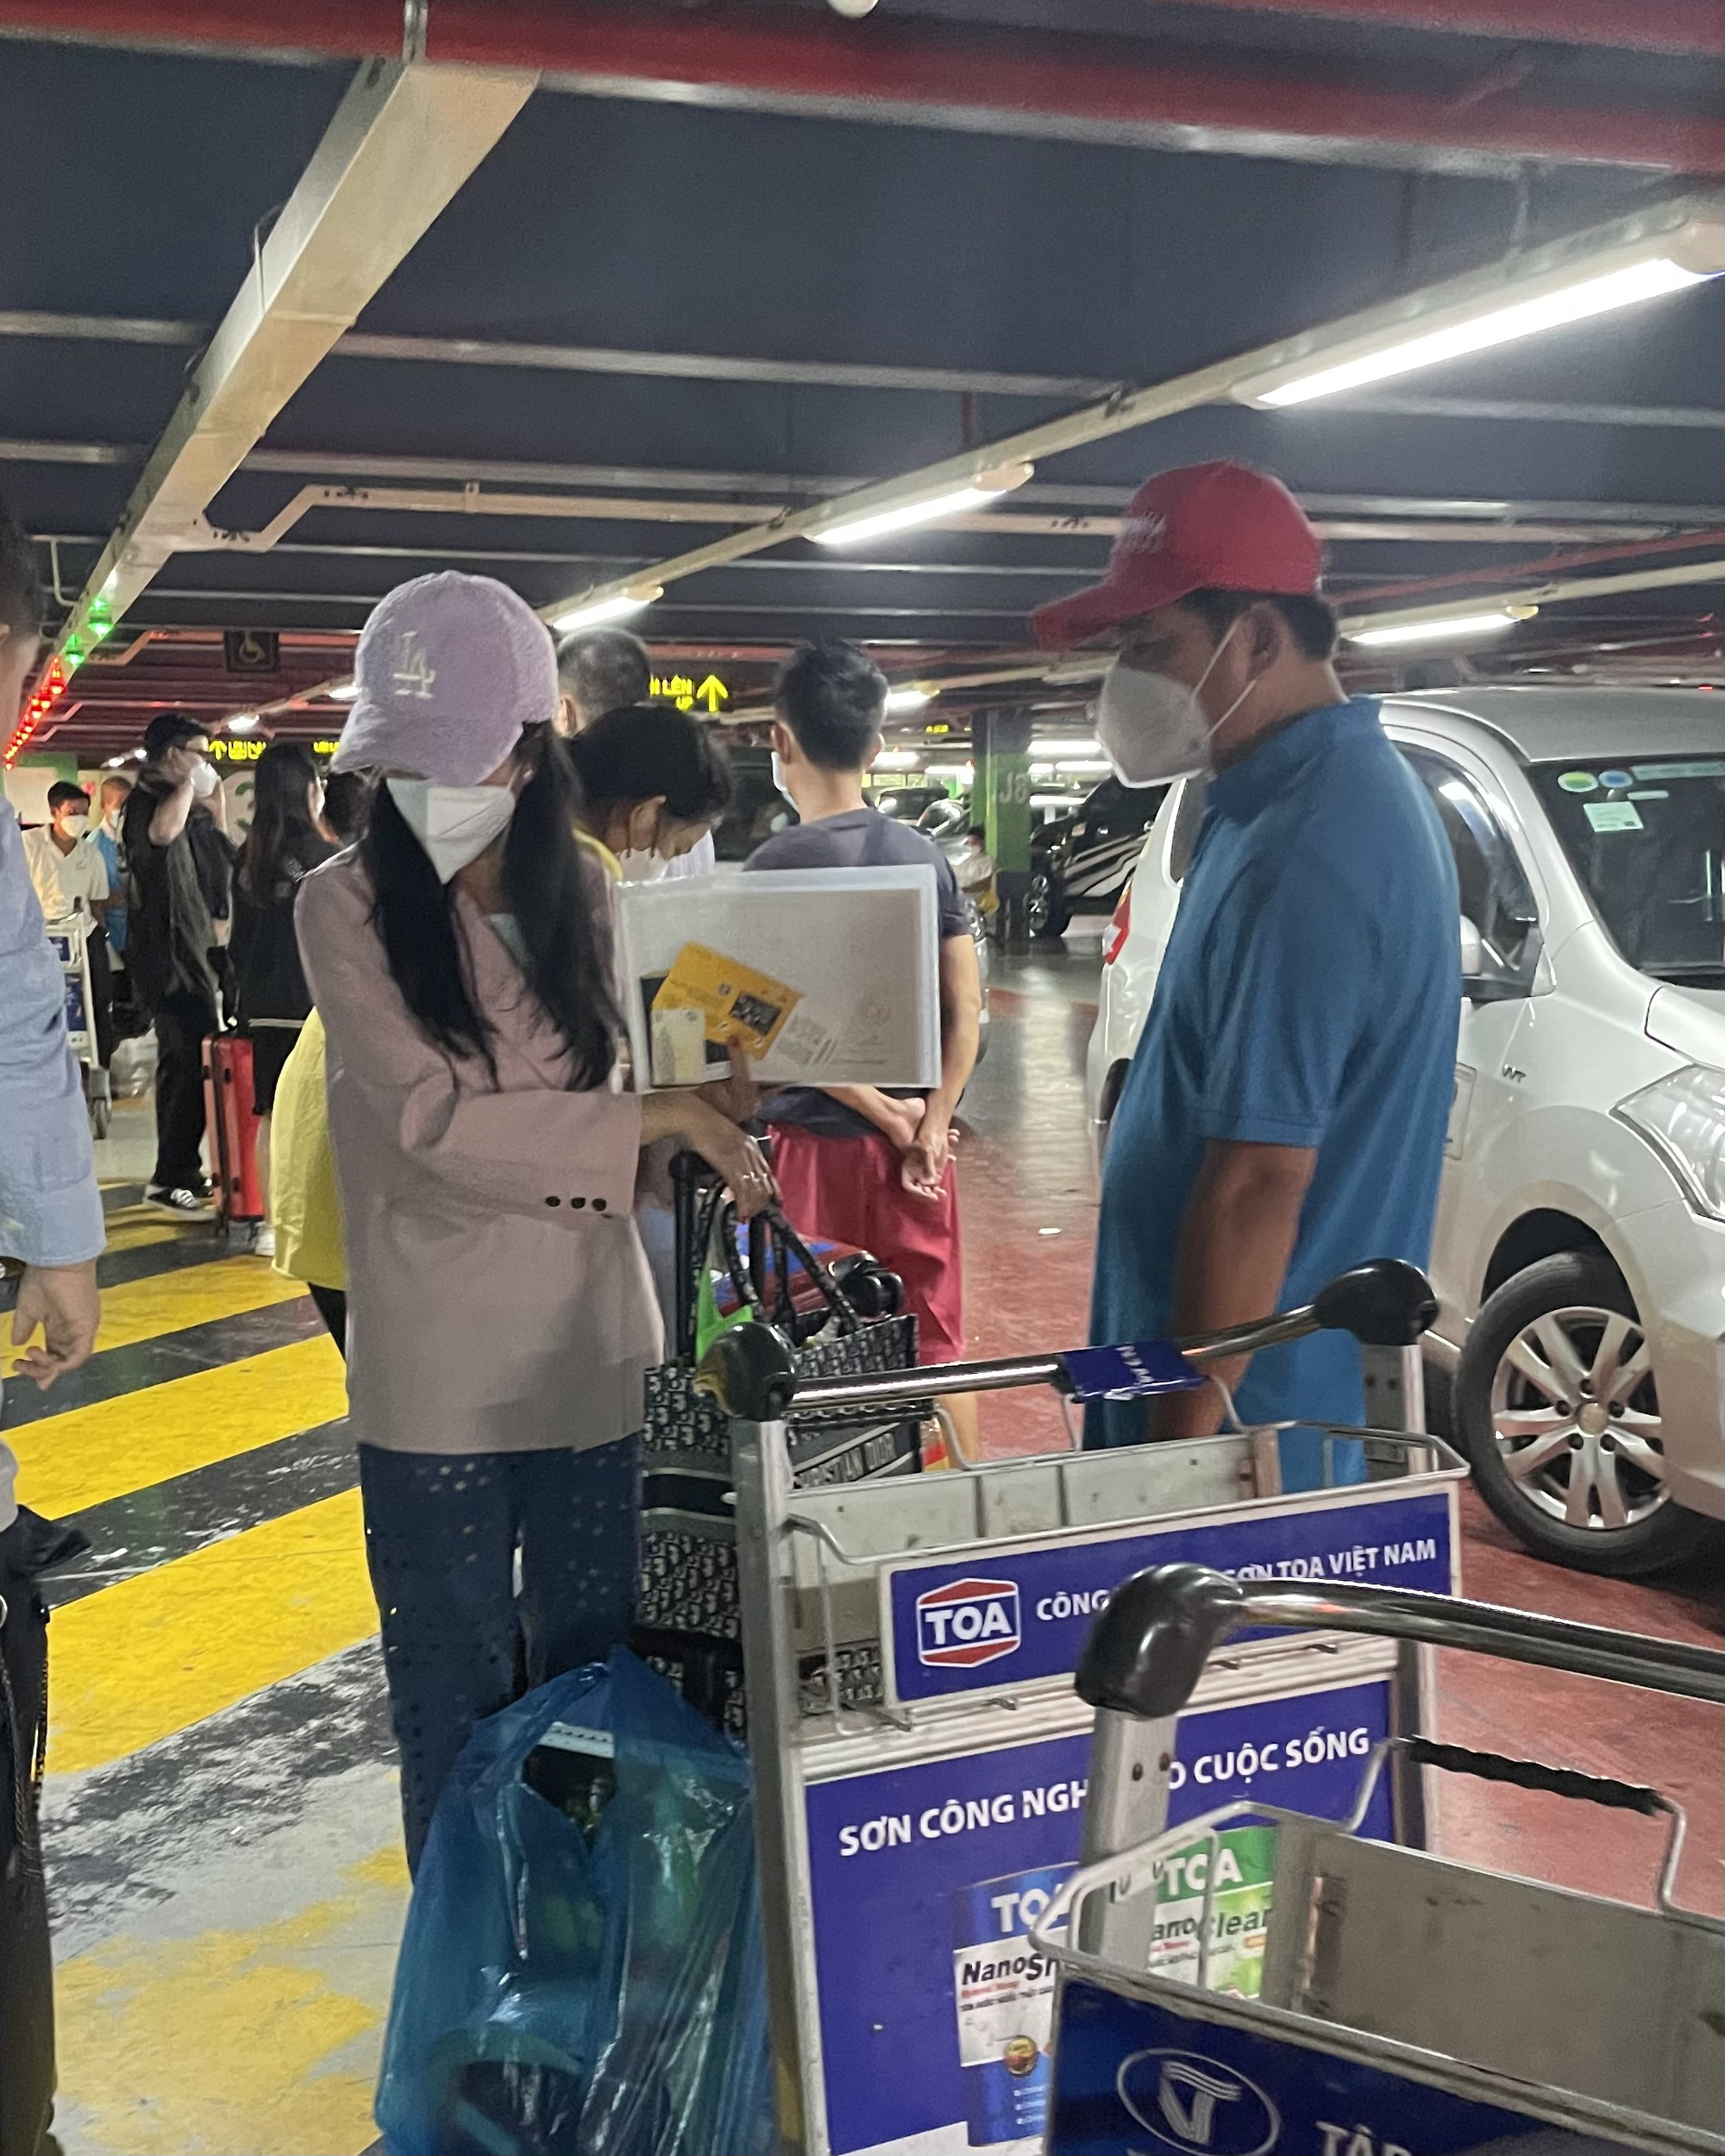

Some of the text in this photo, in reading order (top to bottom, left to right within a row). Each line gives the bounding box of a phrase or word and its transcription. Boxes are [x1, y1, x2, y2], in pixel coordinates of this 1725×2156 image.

[1276, 1556, 1325, 1579] TOA
[1328, 1545, 1379, 1577] VIỆT
[1383, 1539, 1437, 1566] NAM
[925, 1601, 1013, 1645] TOA
[1193, 1742, 1279, 1784] CUỘC
[1285, 1726, 1370, 1768] SỐNG
[838, 1778, 1088, 1857] SƠN CÔNG NGH
[1164, 1848, 1244, 1896] TOA
[990, 1883, 1063, 1933] TO
[1316, 2121, 1413, 2156] TÂ
